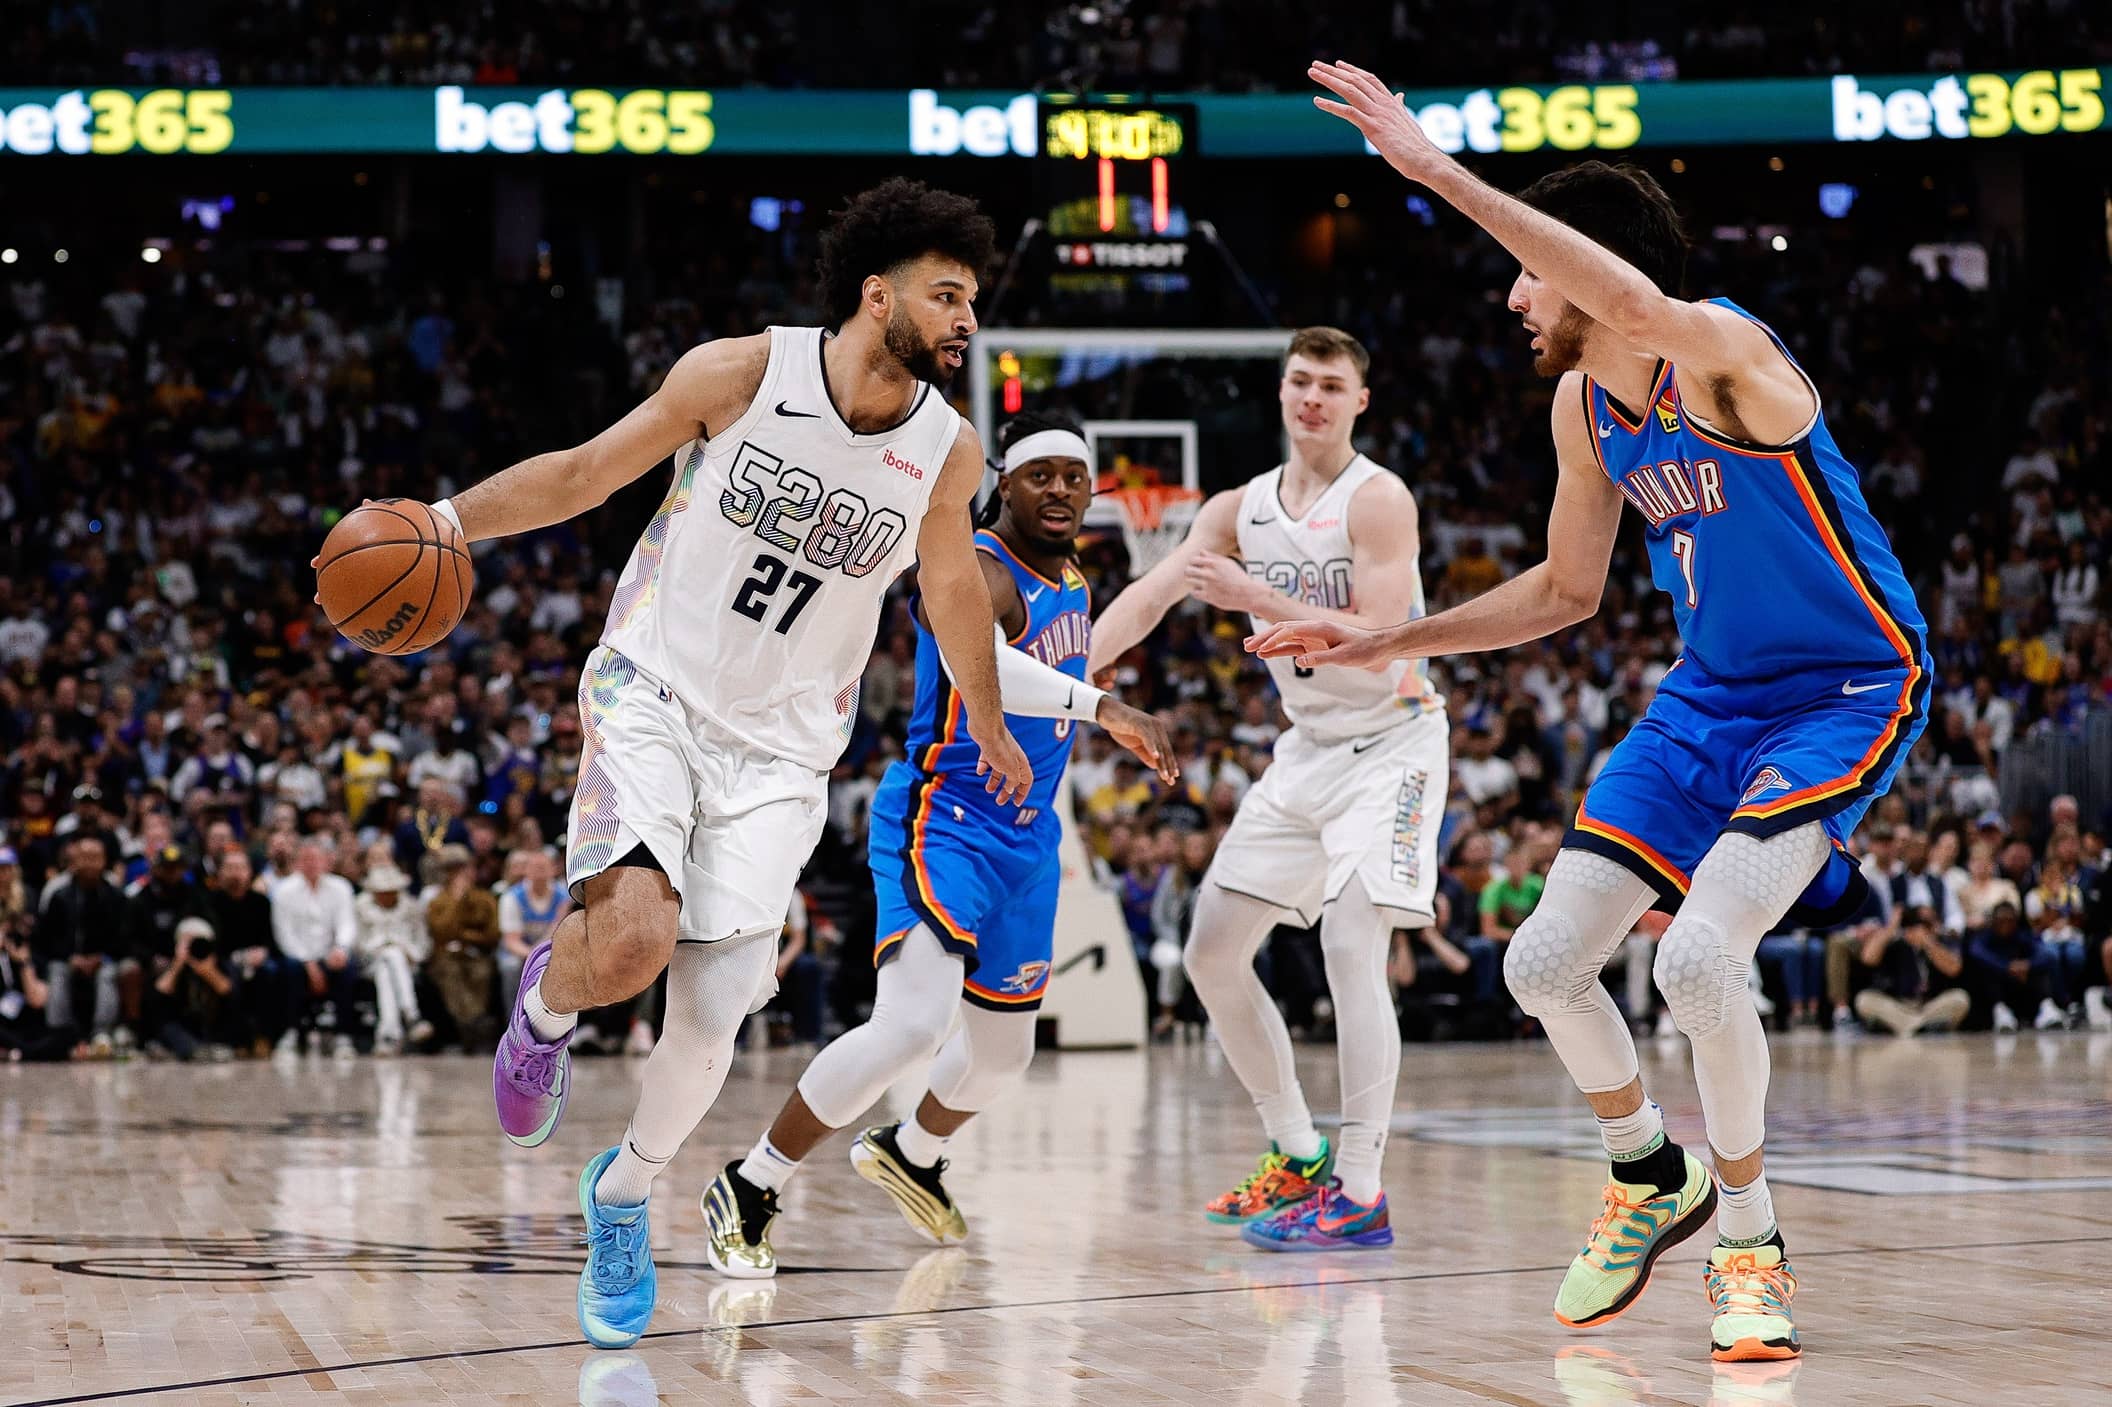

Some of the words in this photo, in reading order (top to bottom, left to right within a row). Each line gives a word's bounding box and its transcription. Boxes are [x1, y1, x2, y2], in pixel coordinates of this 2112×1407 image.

[0, 89, 234, 154] et365
[435, 86, 714, 153] bet365
[908, 88, 1037, 156] bet
[1366, 85, 1641, 154] et365
[1832, 69, 2104, 141] bet365
[882, 449, 923, 480] ibotta
[720, 441, 907, 578] 5280
[731, 554, 823, 635] 27
[1673, 530, 1696, 608] 7
